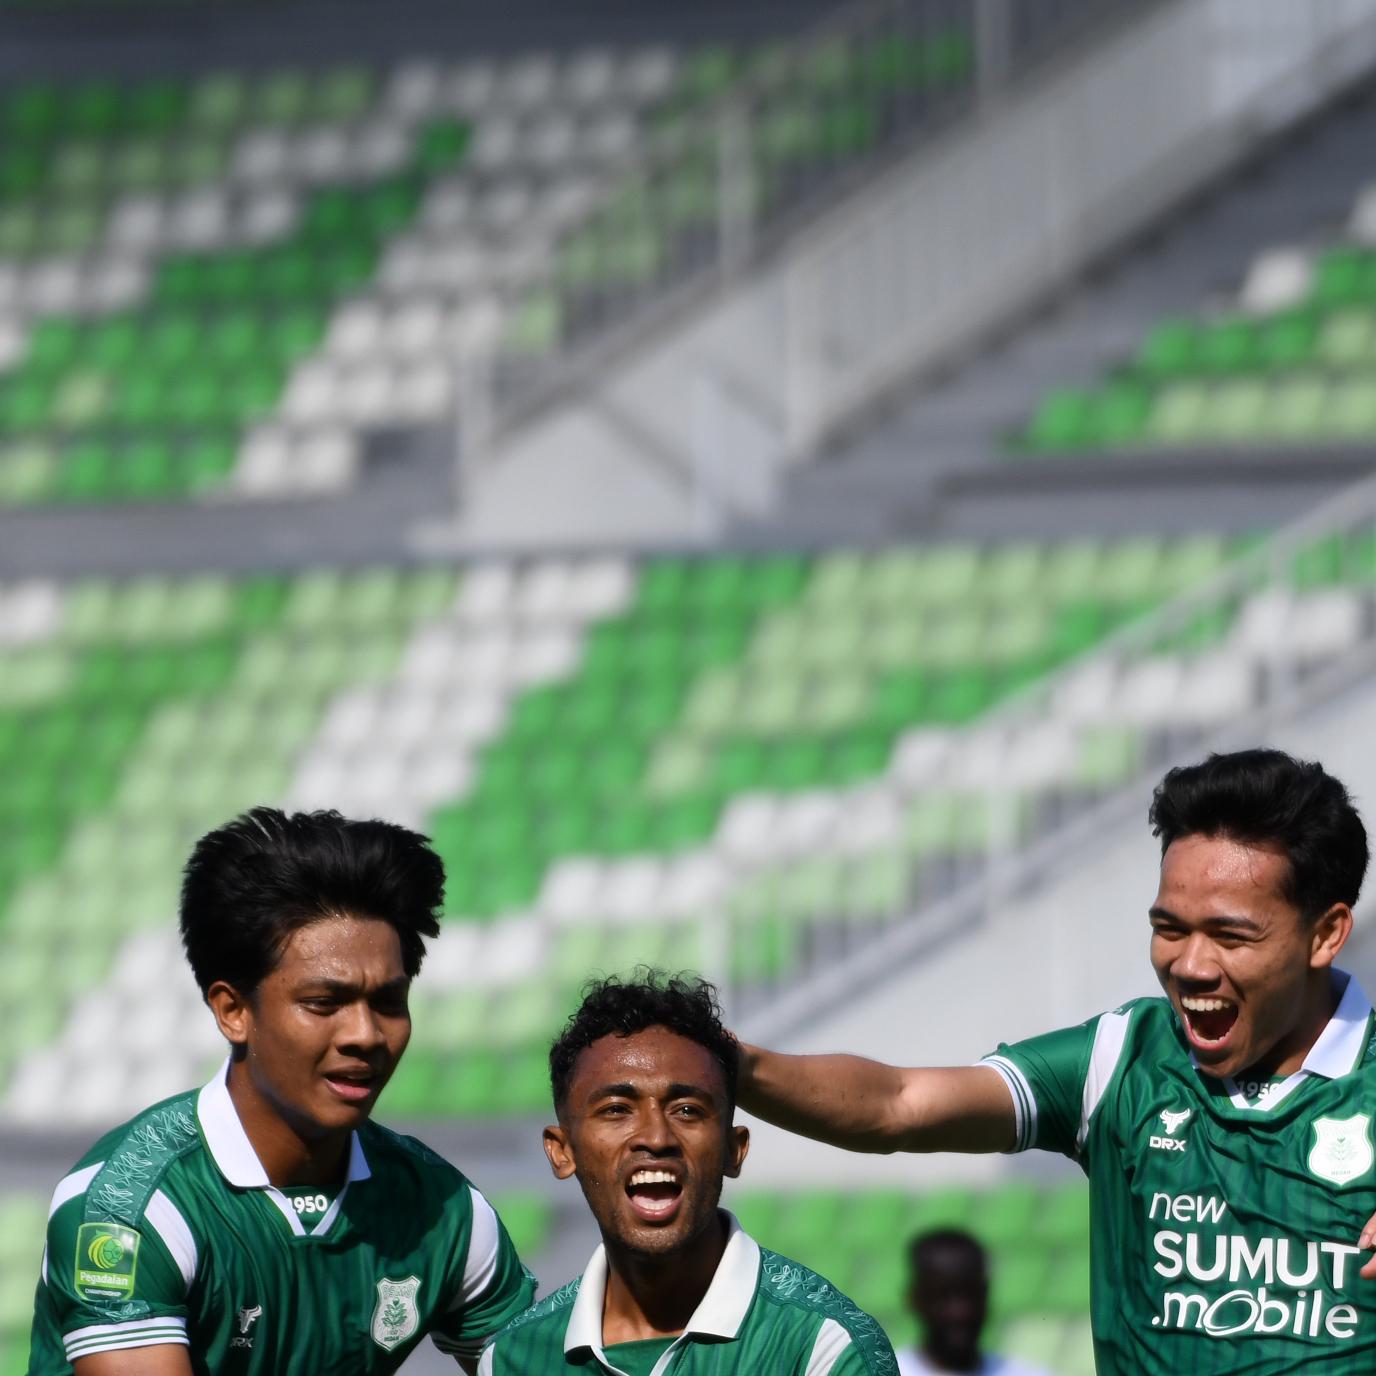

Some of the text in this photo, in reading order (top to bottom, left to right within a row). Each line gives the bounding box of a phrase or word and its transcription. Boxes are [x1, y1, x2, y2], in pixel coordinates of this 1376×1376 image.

[1149, 1135, 1187, 1152] DRX
[1149, 1192, 1226, 1223] new
[1153, 1230, 1360, 1289] SUMUT
[1152, 1287, 1358, 1339] .mobile
